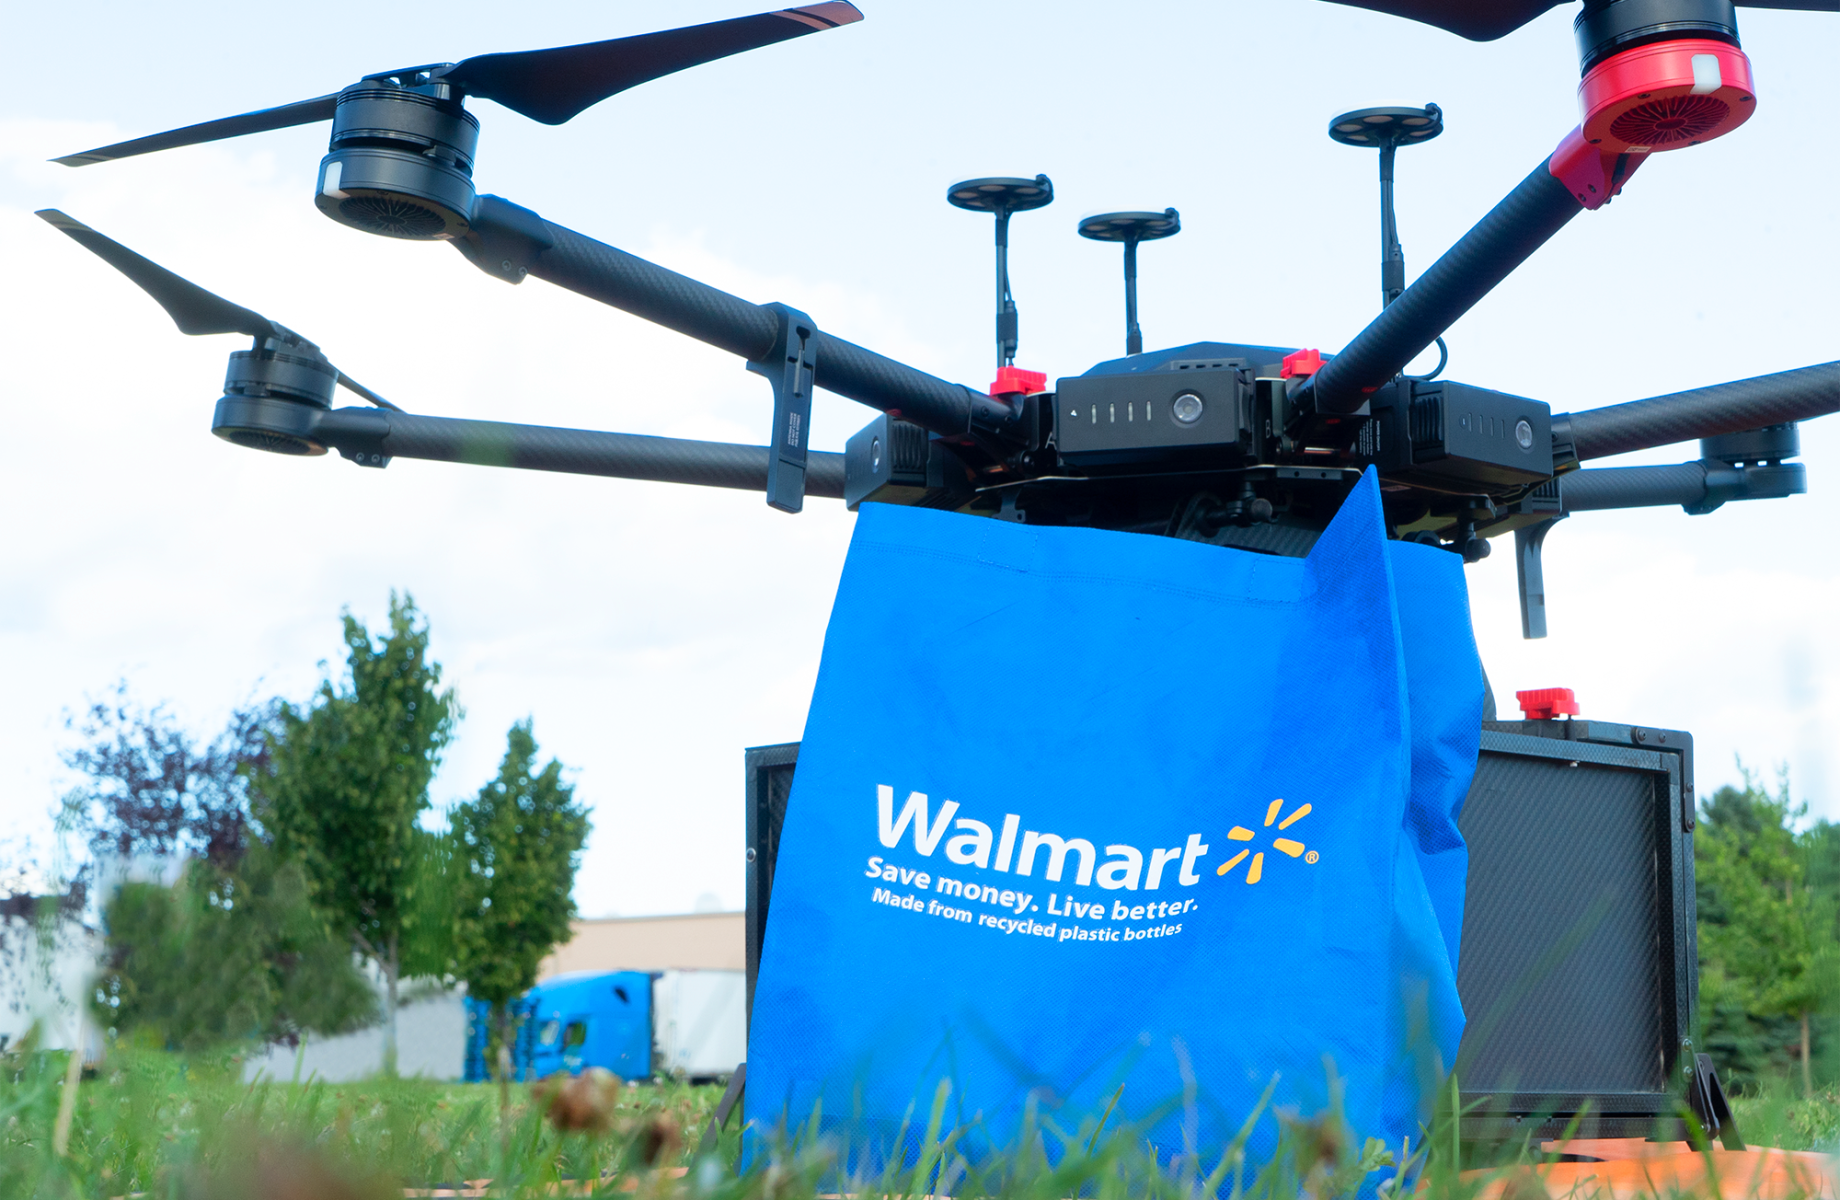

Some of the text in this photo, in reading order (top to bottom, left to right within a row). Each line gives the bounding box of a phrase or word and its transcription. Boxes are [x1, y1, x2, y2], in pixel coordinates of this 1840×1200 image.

[876, 783, 1210, 891] Walmart
[865, 855, 1199, 921] Save money. Live better.
[871, 886, 1183, 943] Made from recycled plastic bottles
